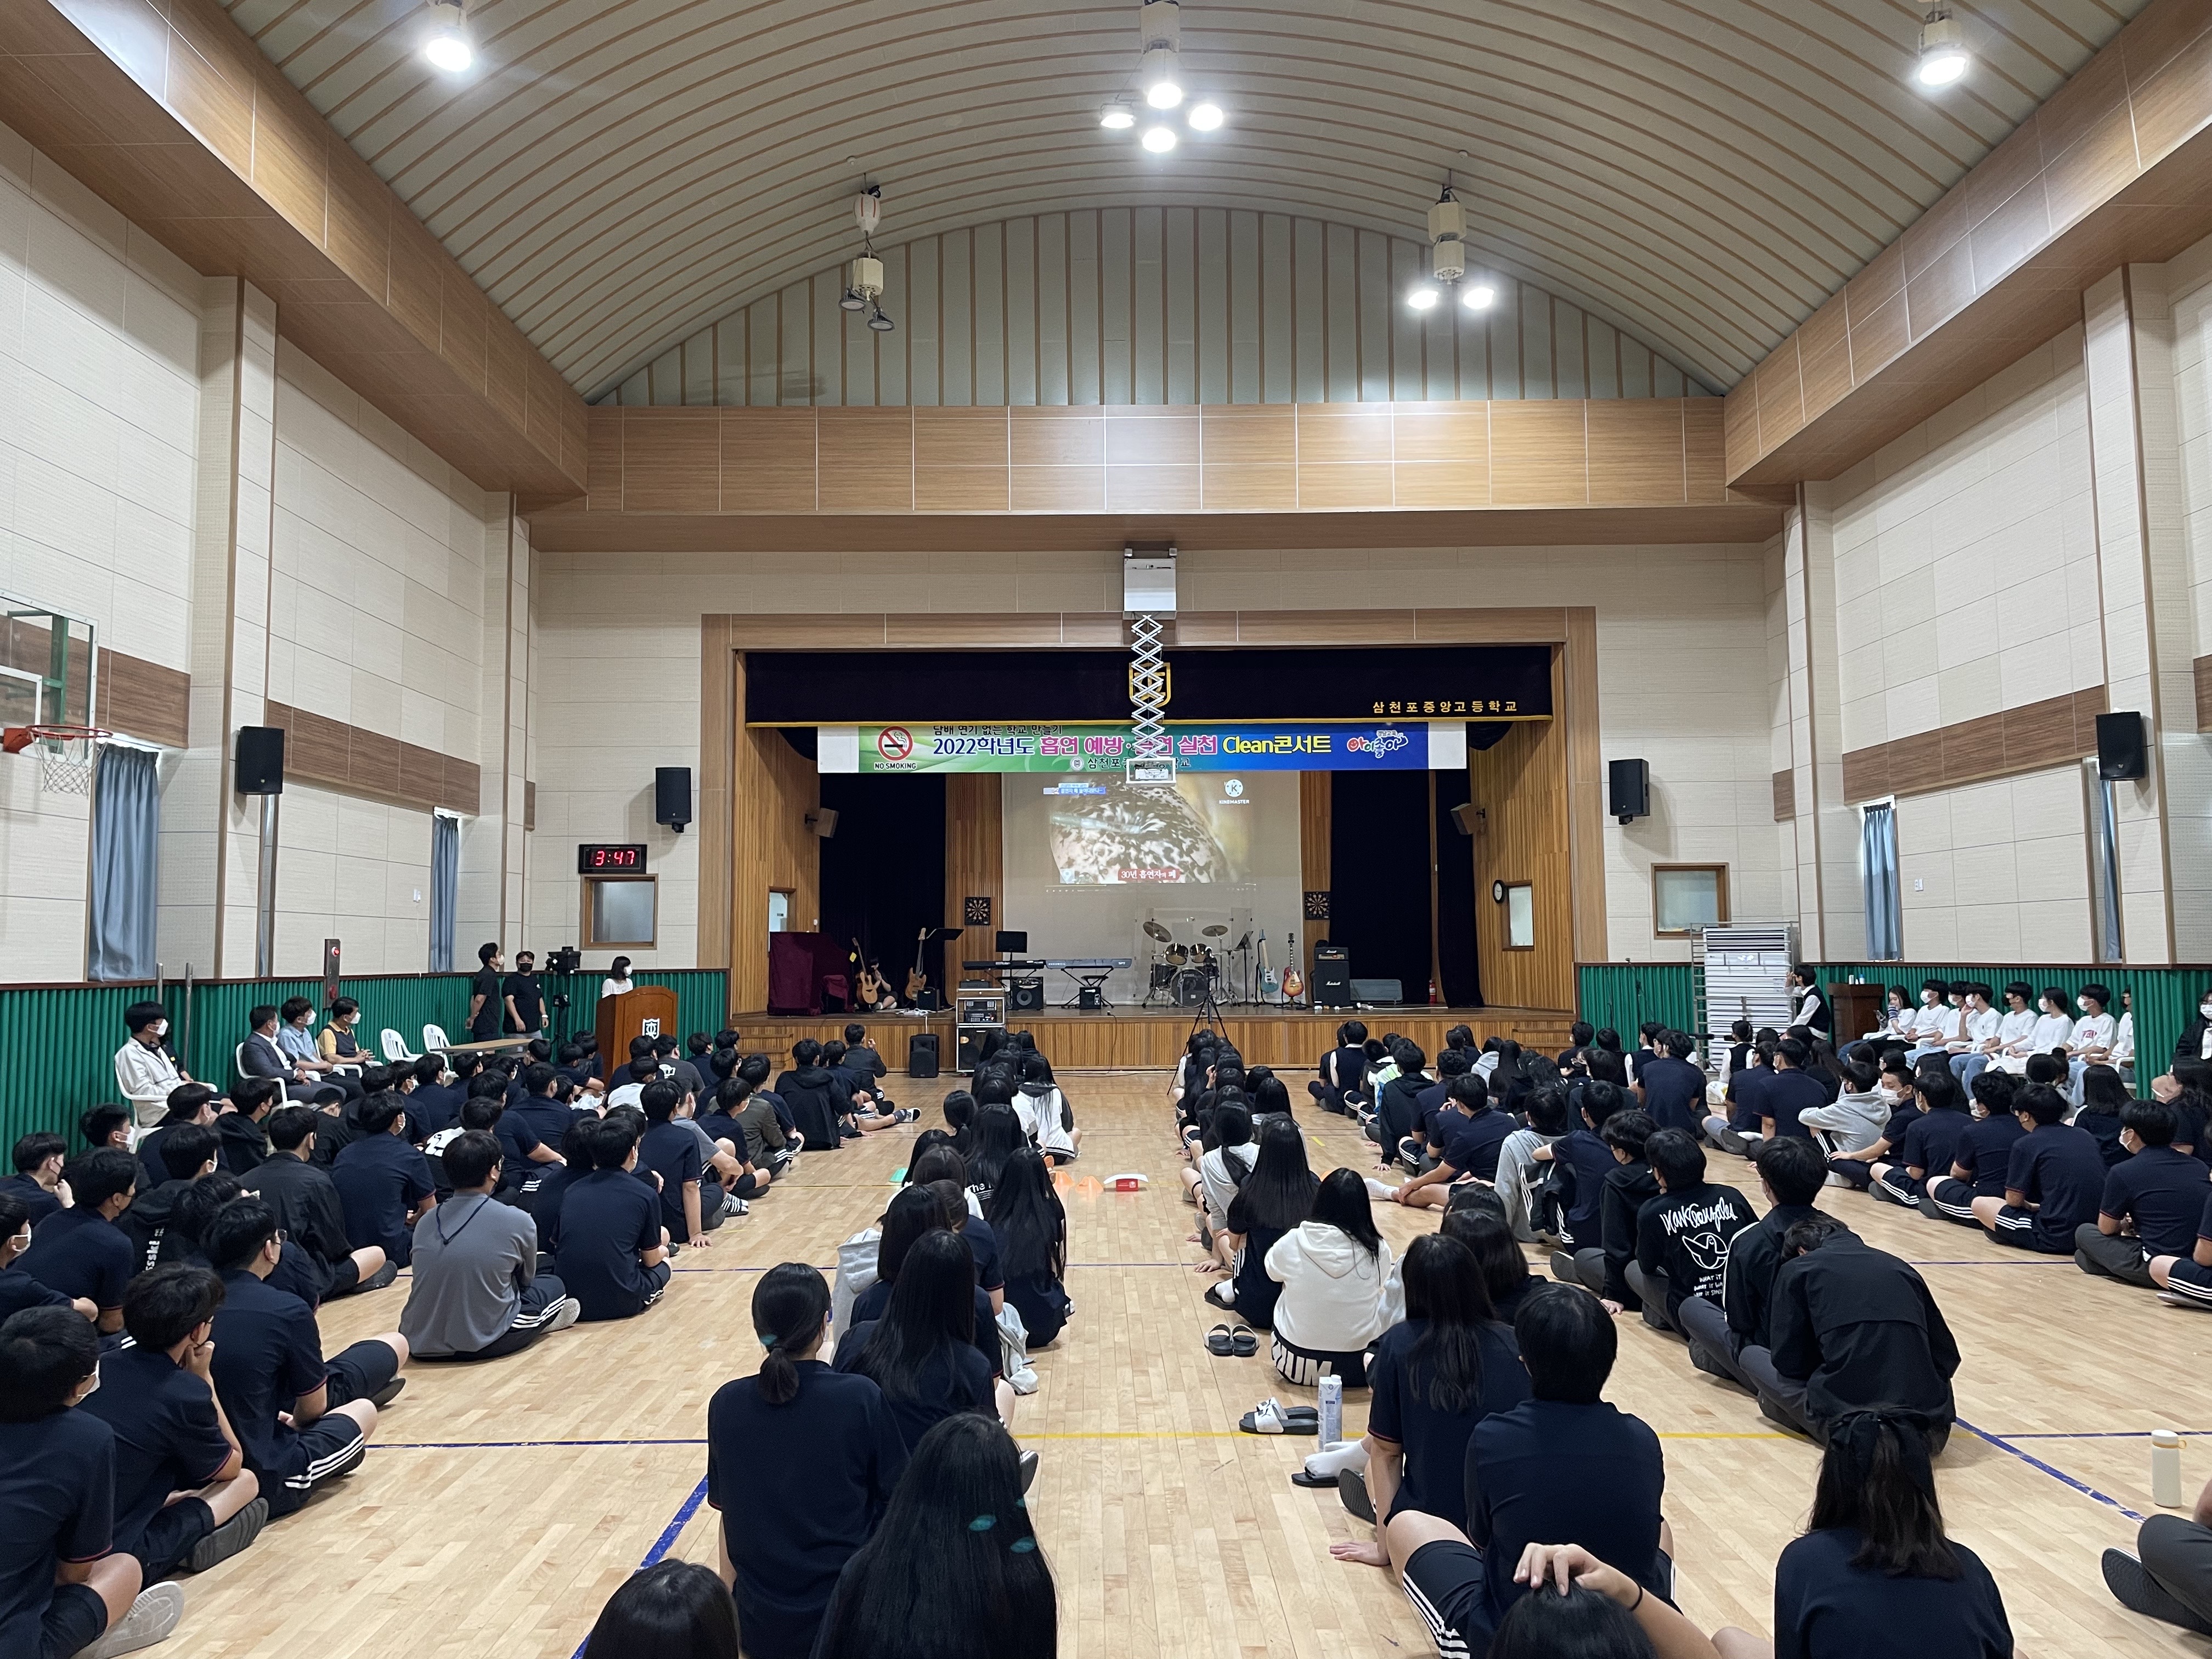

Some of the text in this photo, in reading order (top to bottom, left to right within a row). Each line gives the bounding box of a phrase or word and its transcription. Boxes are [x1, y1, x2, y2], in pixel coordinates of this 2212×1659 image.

[1373, 701, 1517, 713] 삼천포중앙고등학교
[934, 725, 1063, 735] 담배 연기 없는 학교 만들기
[934, 737, 1035, 755] 2022학년도
[1041, 737, 1078, 755] 흡연
[1178, 735, 1217, 754] 실천
[1223, 735, 1331, 754] Clean콘서트
[595, 850, 635, 866] 3:47
[1121, 870, 1138, 879] 30년
